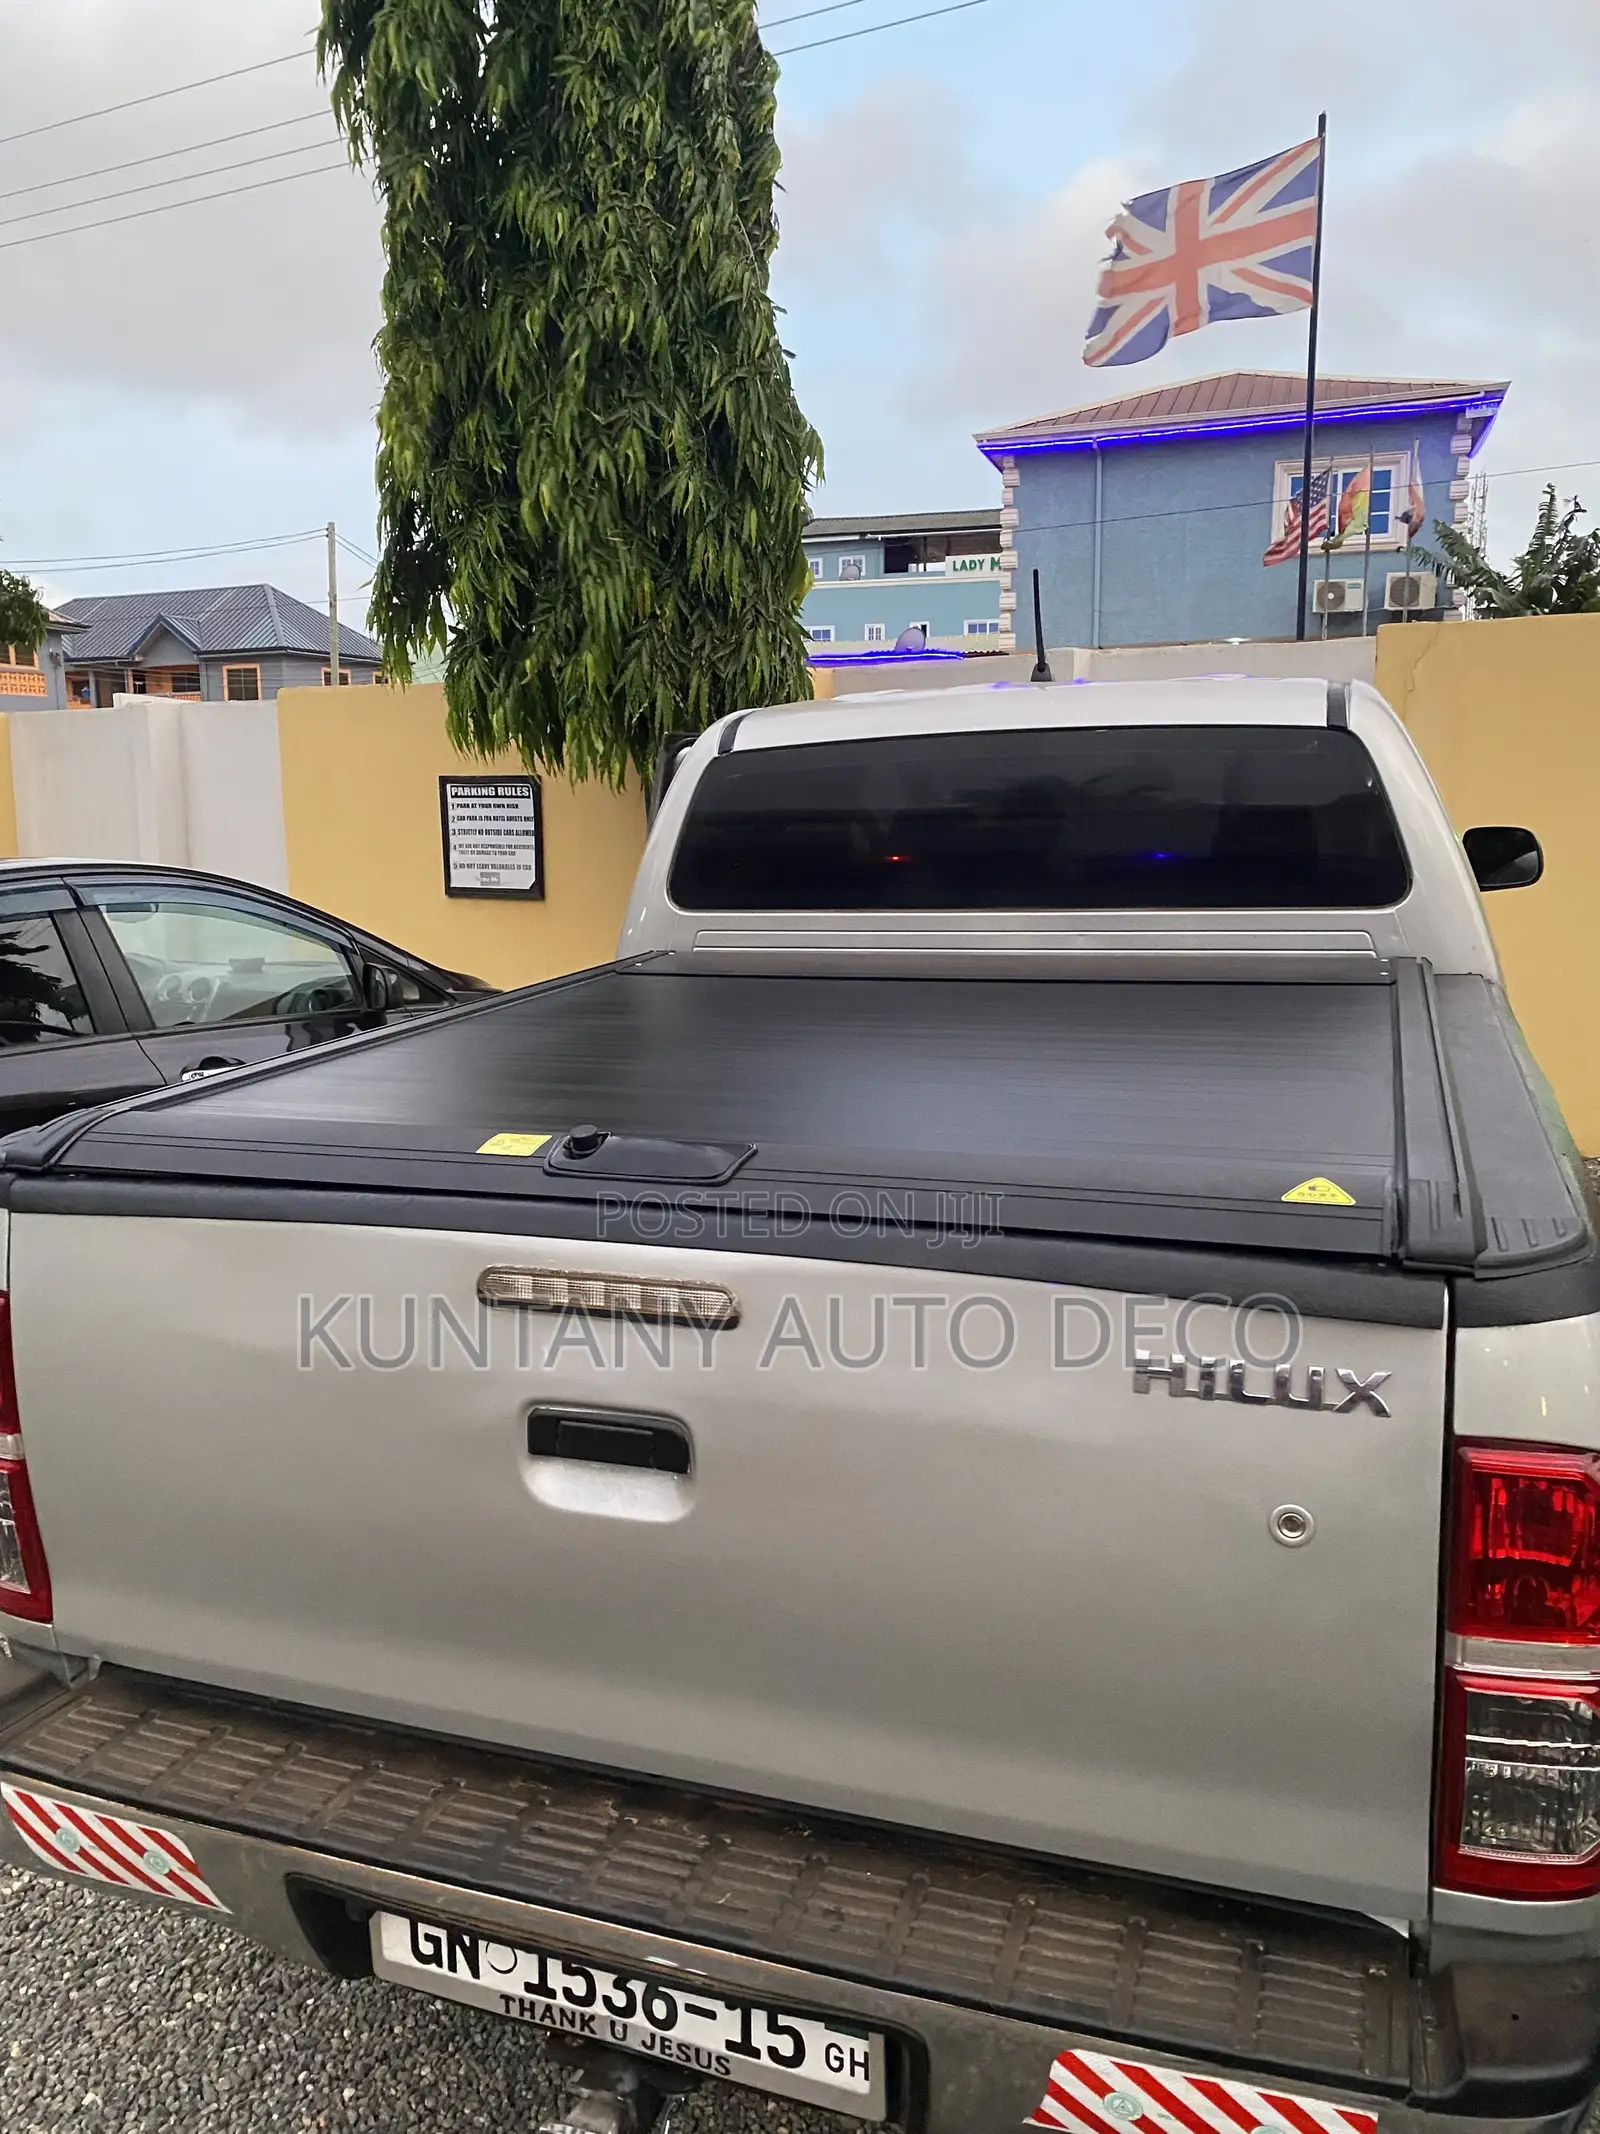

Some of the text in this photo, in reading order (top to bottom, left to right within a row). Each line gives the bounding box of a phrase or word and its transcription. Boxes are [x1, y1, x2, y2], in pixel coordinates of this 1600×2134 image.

[952, 558, 985, 571] LADY
[451, 786, 530, 796] PARKING RULES
[1132, 1348, 1392, 1418] HILUX
[408, 1918, 481, 1980] GN
[824, 2042, 870, 2082] GH
[499, 1994, 731, 2077] THANK U JESUS
